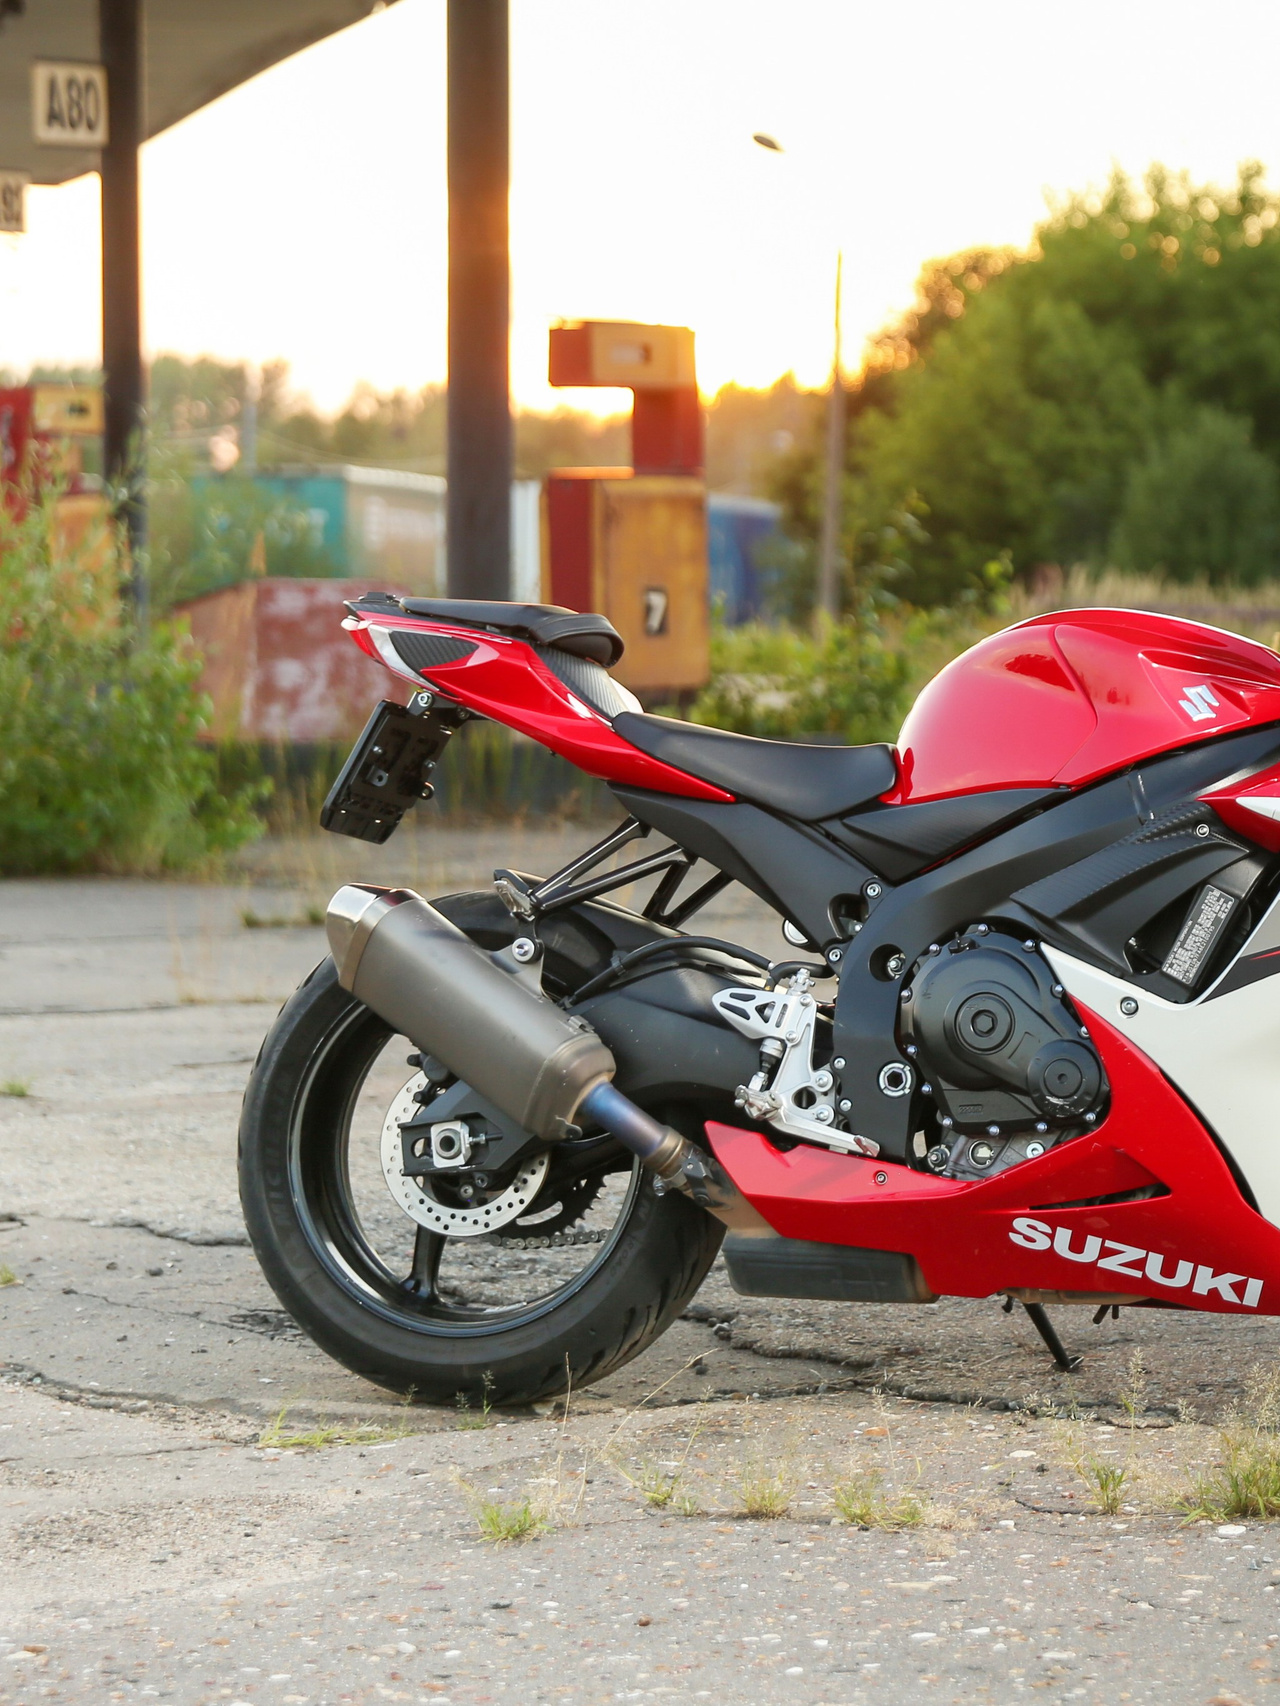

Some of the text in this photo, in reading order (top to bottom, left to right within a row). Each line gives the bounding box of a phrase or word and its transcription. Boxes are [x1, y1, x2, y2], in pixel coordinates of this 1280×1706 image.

[47, 74, 100, 131] A80
[648, 590, 667, 631] 7
[1009, 1217, 1264, 1307] SUZUKI
